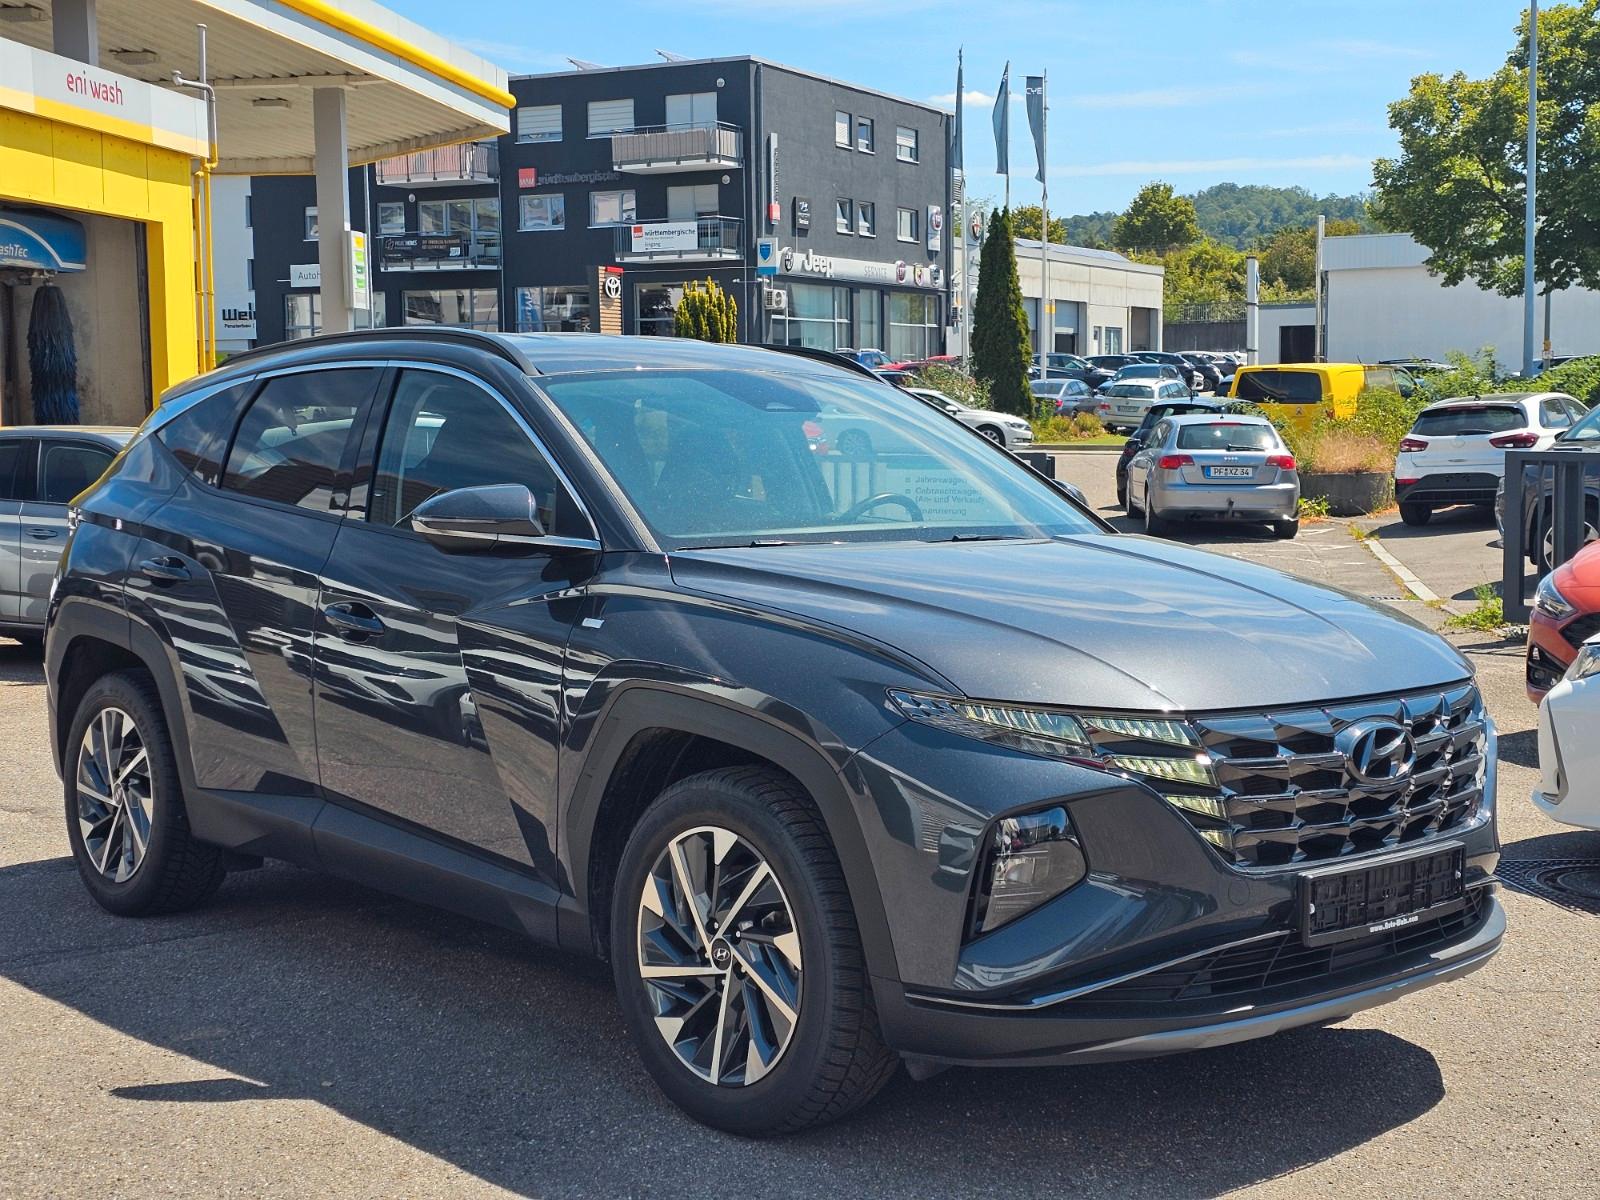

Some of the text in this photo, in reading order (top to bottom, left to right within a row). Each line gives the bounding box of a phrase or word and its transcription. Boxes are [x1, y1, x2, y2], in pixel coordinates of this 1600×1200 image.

[66, 71, 123, 105] eni wash
[645, 228, 696, 237] württembergische
[804, 249, 834, 278] Jeep
[1213, 468, 1250, 476] PF XZ 34
